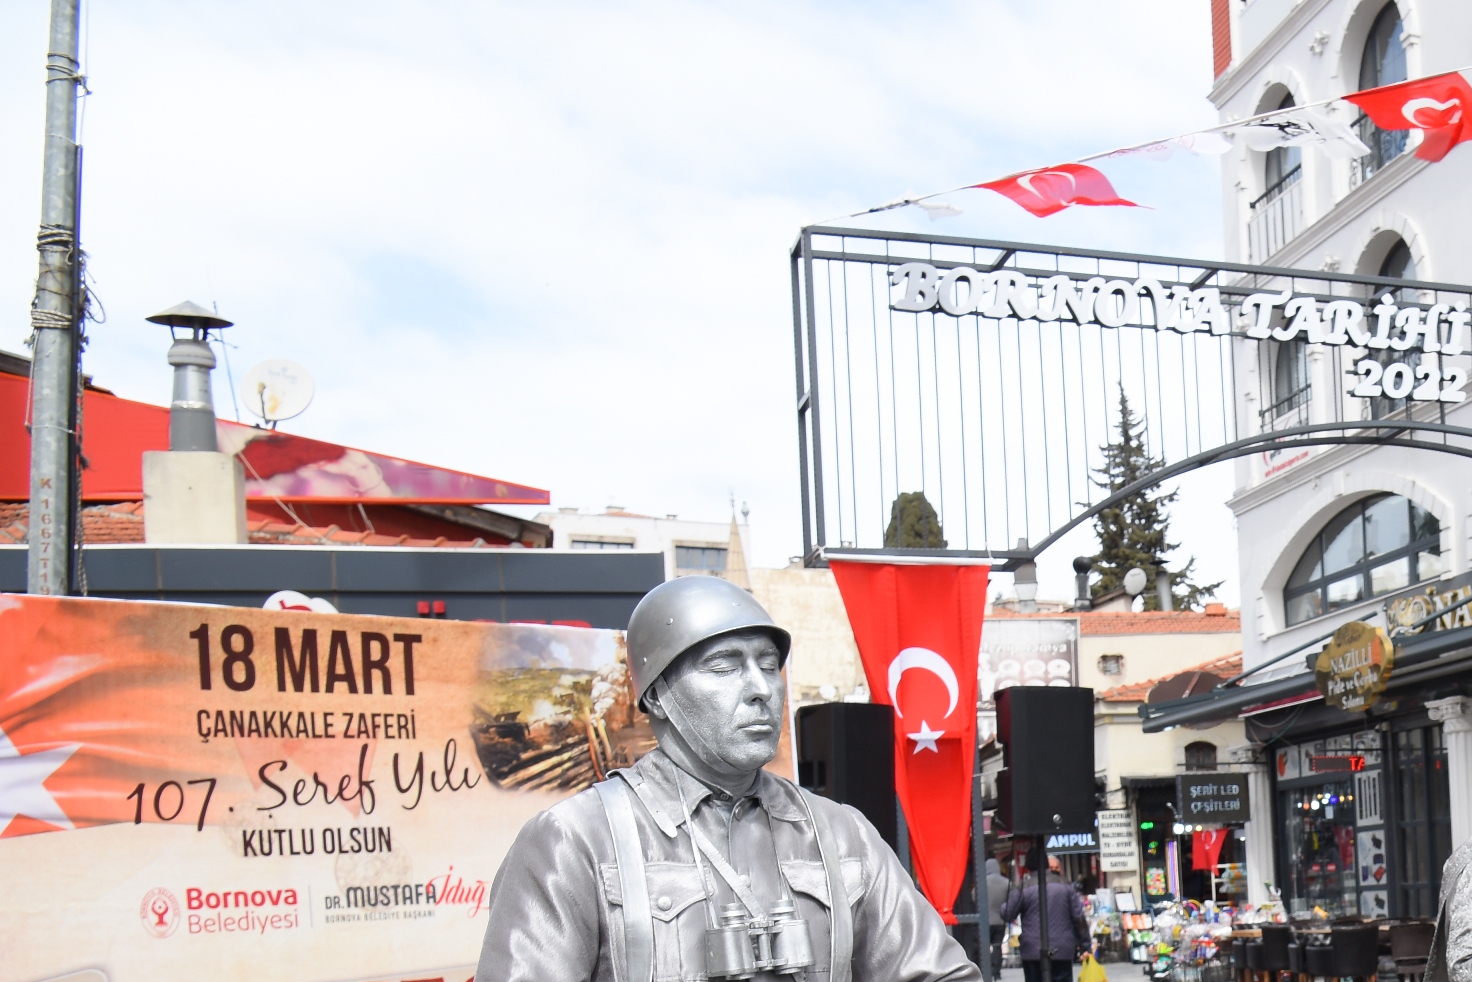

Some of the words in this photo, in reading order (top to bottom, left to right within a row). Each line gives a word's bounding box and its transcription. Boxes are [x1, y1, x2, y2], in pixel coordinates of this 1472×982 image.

[892, 262, 1230, 336] BORNOVA
[1241, 289, 1472, 355] TARİHİ
[1353, 359, 1468, 402] 2022
[189, 623, 256, 692] 18
[274, 627, 422, 696] MART
[196, 709, 335, 743] ÇANAKKALE
[343, 709, 416, 739] ZAFERİ
[127, 778, 234, 832] 107.
[257, 743, 376, 819] Şeref
[392, 738, 481, 810] Yılı
[1220, 784, 1240, 796] LED
[242, 829, 314, 857] KUTLU
[323, 826, 392, 854] OLSUN
[1046, 833, 1096, 848] AMPUL
[186, 887, 298, 911] Bornova
[325, 896, 344, 910] DR.
[346, 883, 436, 908] MUSTAFA
[187, 909, 299, 935] Belediyesi
